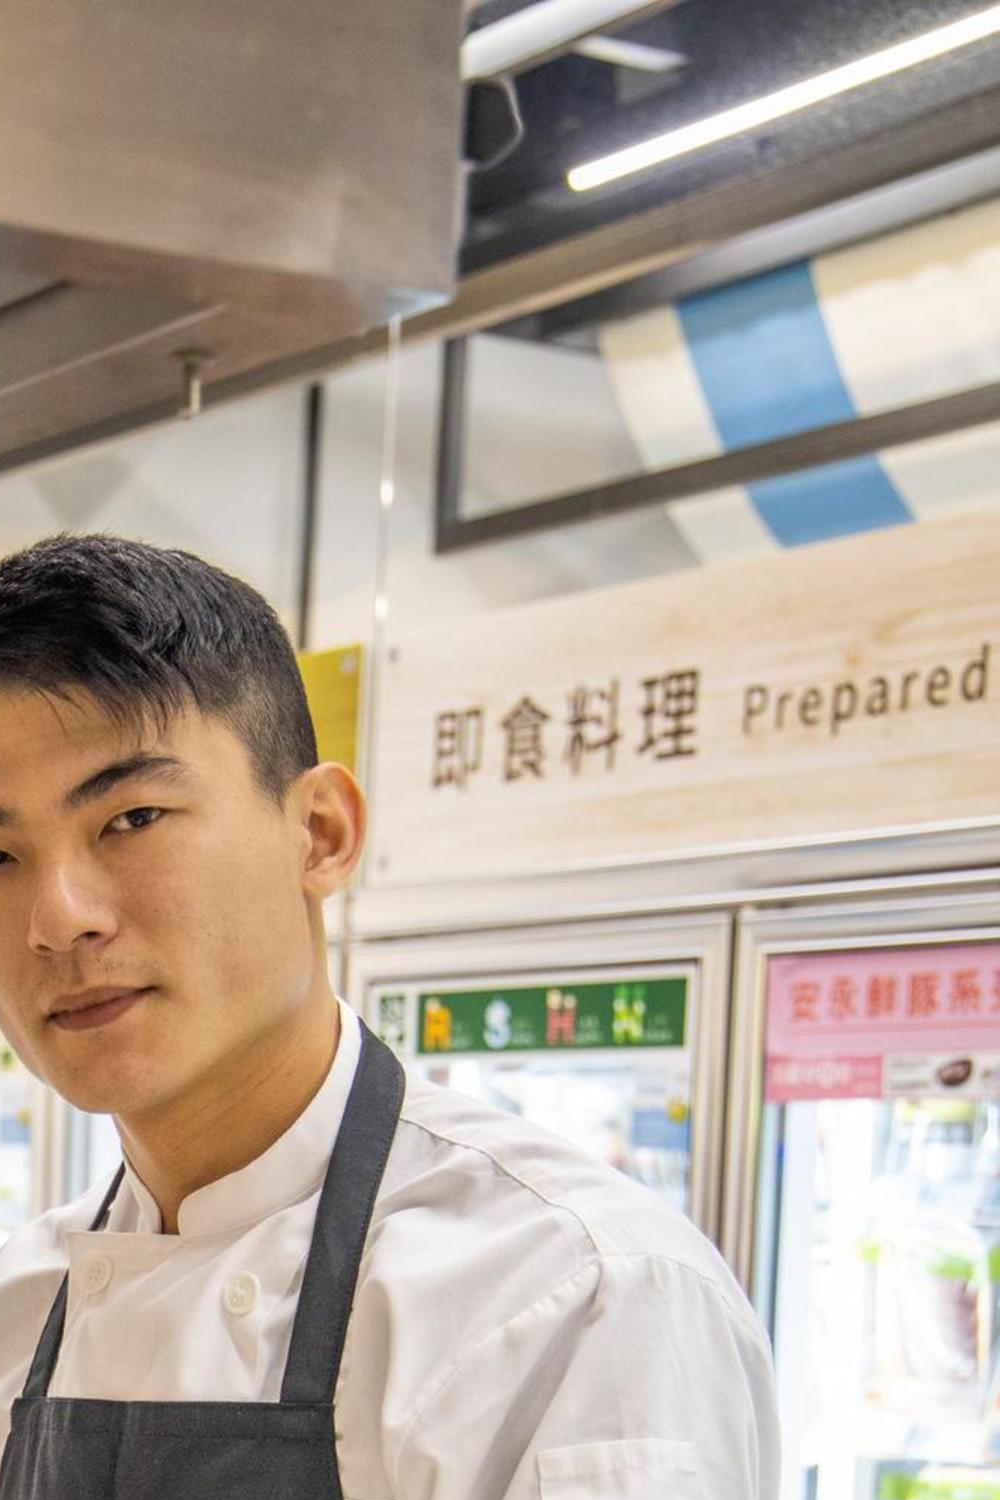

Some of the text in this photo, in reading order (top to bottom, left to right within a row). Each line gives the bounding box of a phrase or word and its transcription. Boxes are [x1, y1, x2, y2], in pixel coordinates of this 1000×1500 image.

[432, 642, 993, 793] 即食料理 Prepared
